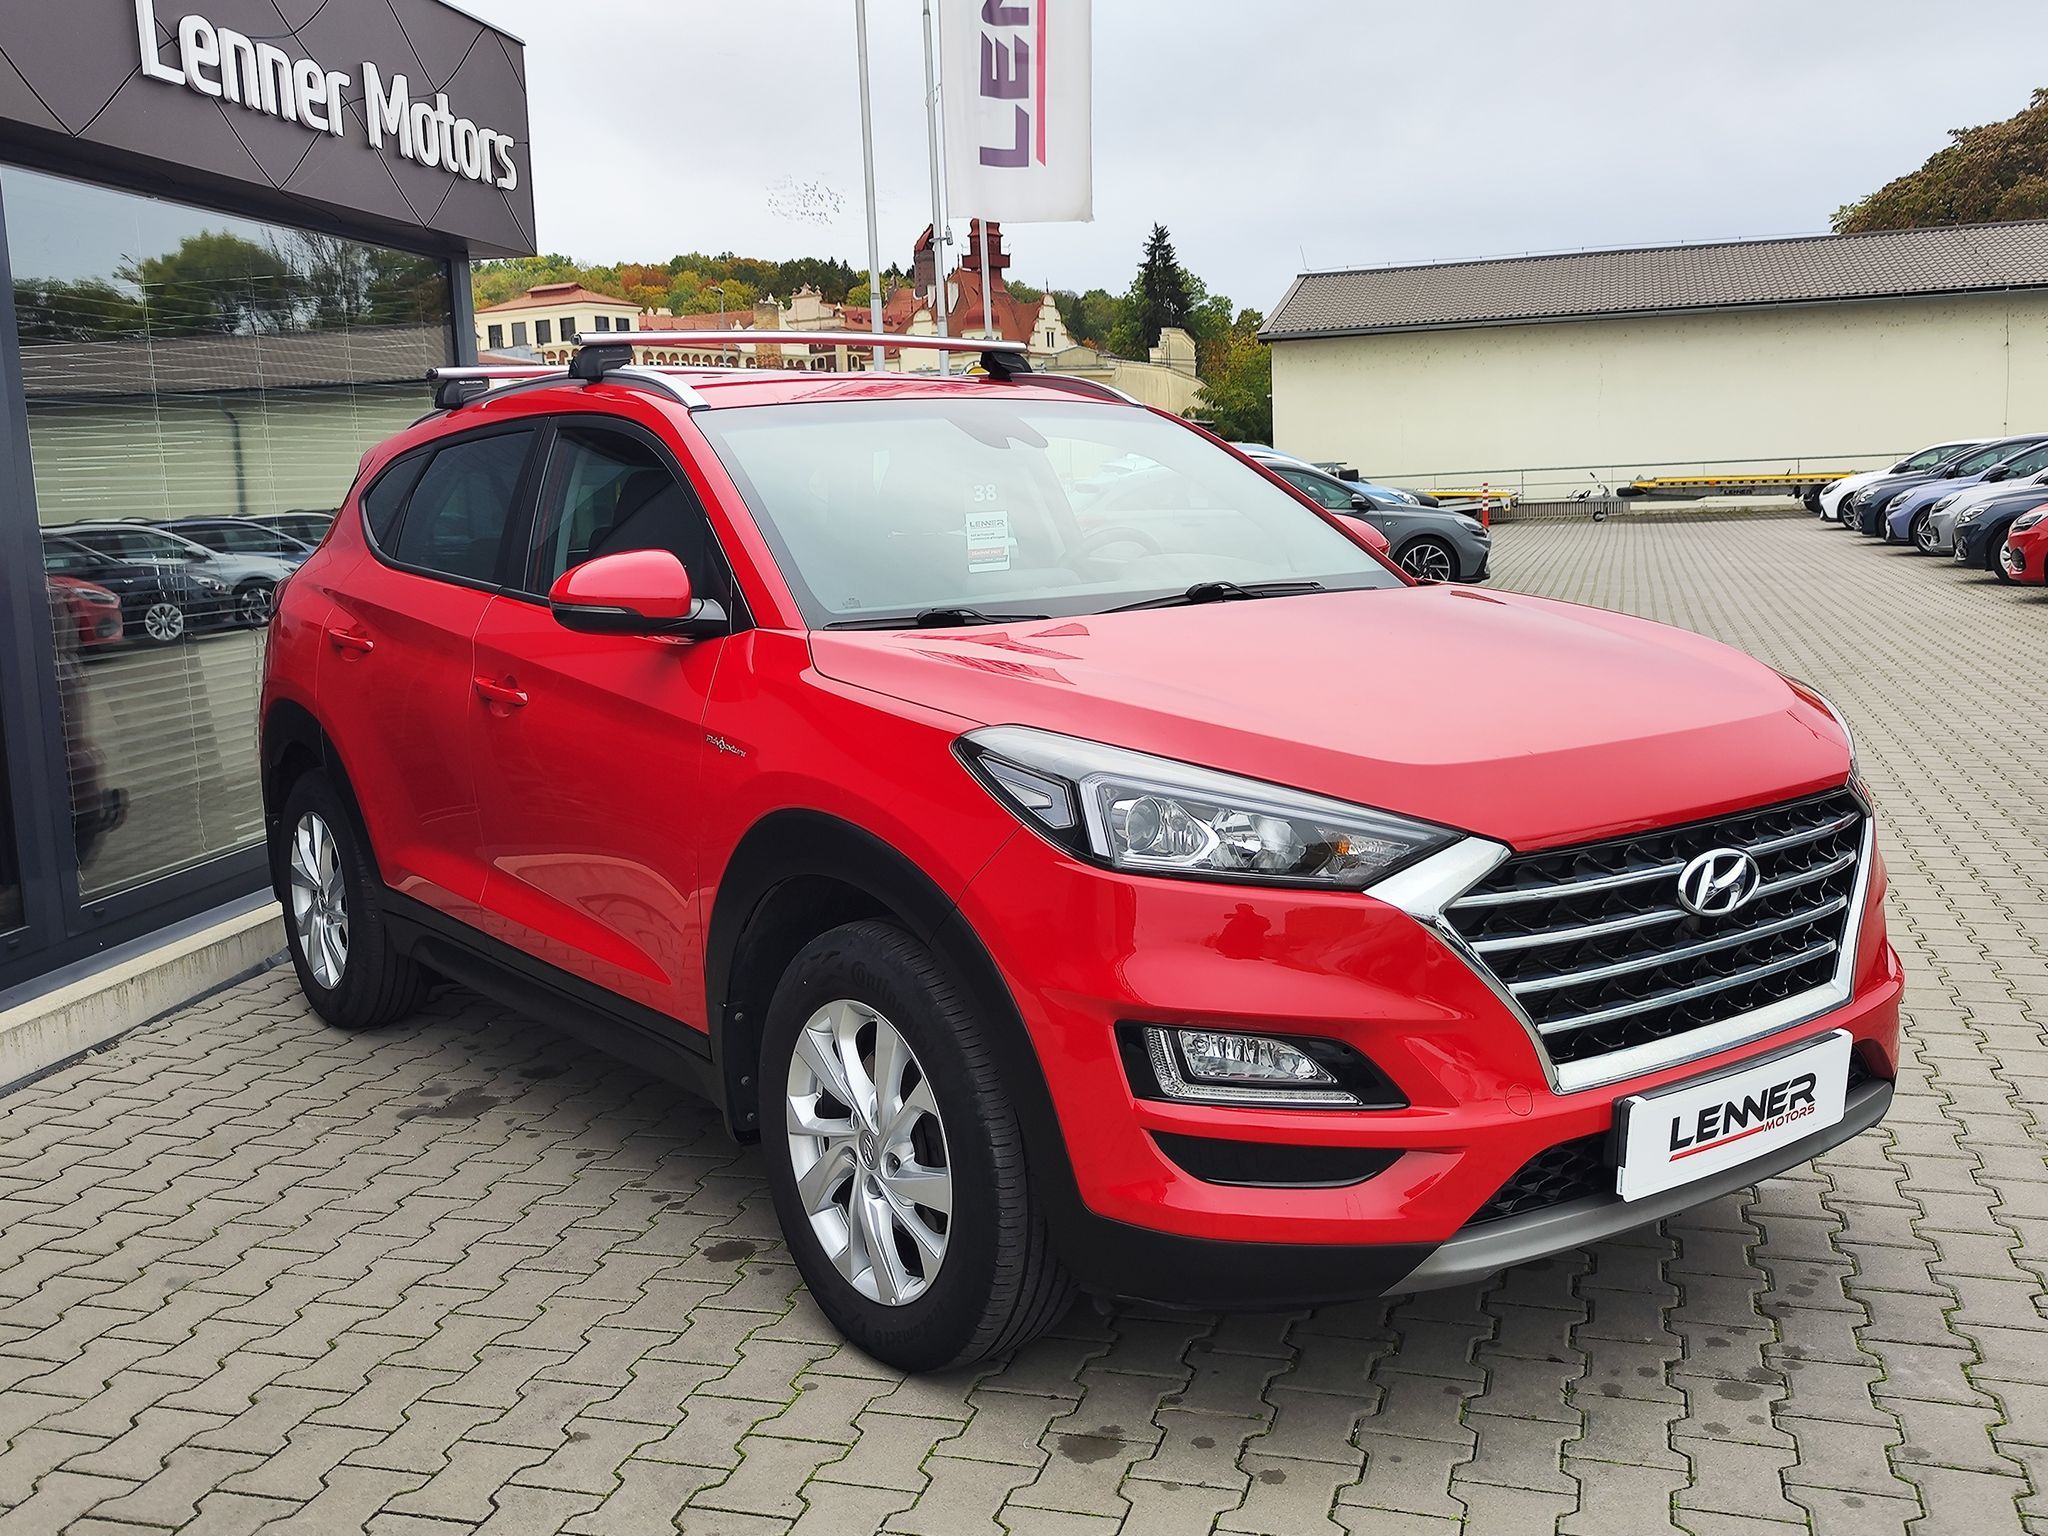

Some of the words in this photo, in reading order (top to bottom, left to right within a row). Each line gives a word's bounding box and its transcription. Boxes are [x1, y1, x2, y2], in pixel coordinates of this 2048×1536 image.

[134, 0, 350, 137] Lenner
[361, 61, 518, 191] Motors
[973, 483, 998, 502] 38
[1669, 1072, 1817, 1151] LENNER
[1764, 1103, 1816, 1132] MOTORS
